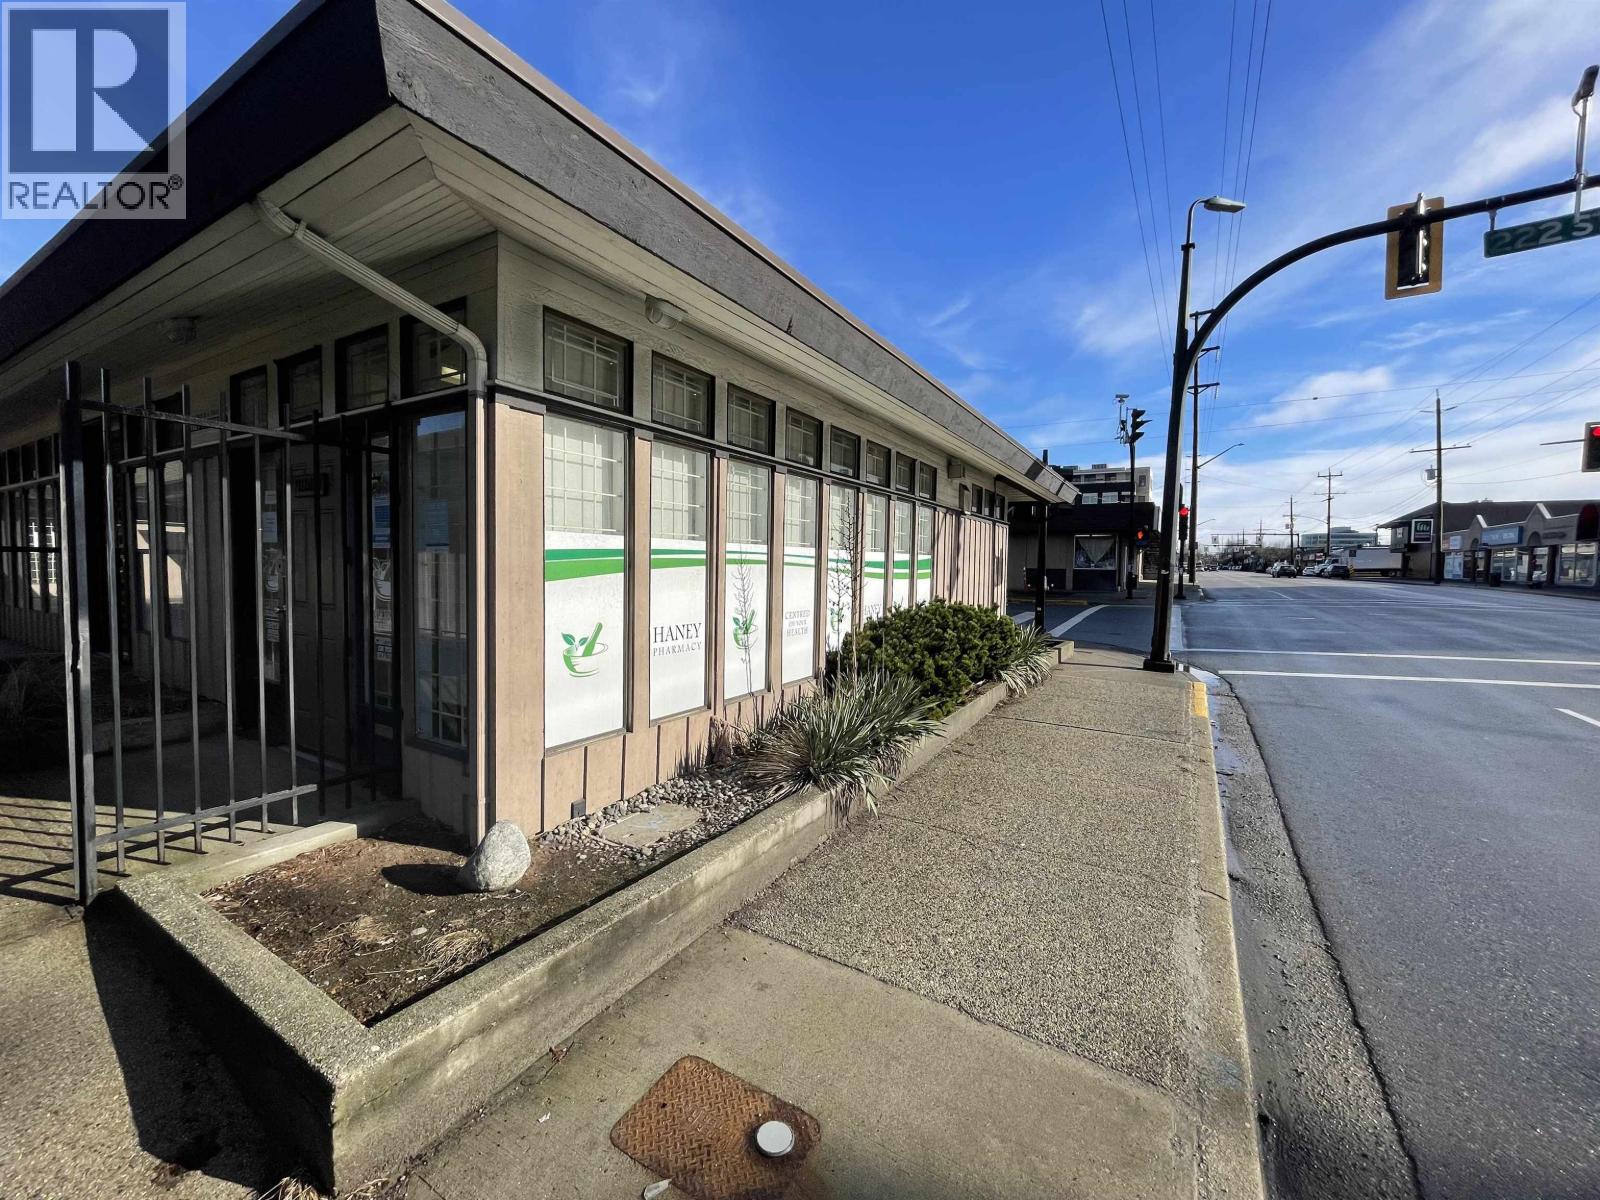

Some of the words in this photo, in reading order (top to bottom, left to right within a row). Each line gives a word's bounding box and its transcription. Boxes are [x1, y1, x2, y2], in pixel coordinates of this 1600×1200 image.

[1491, 221, 1562, 251] 222
[653, 622, 702, 644] HANEY
[786, 627, 808, 637] HEALTH
[653, 641, 702, 657] PHARMACY
